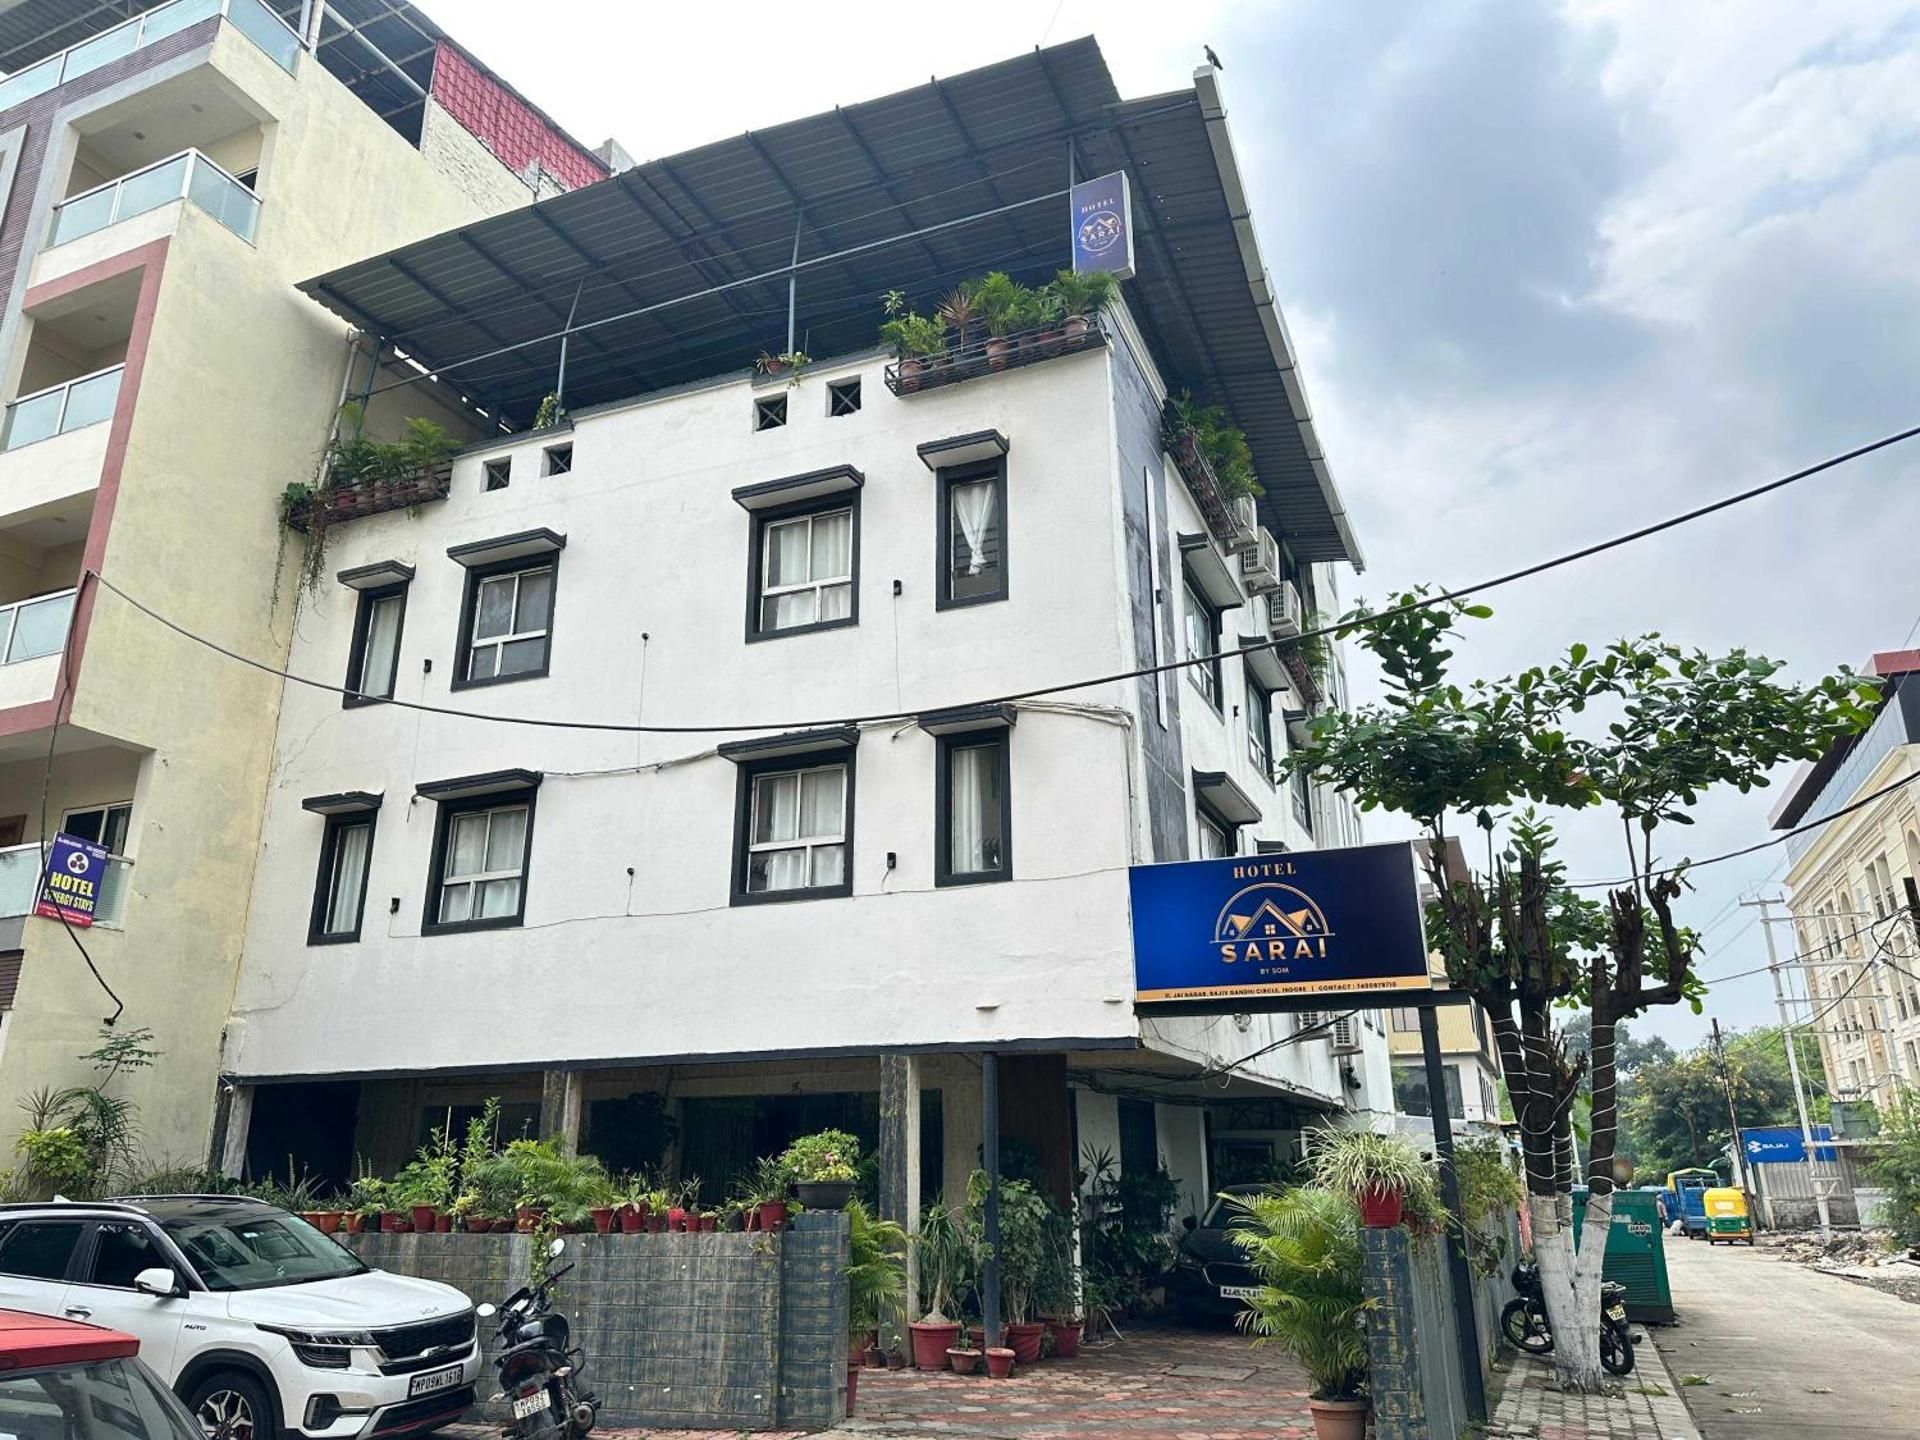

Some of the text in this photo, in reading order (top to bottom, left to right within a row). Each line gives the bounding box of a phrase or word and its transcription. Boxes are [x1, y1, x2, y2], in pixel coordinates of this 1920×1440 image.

[1233, 862, 1297, 879] HOTEL
[50, 872, 94, 897] HOTEL
[73, 897, 94, 912] STAYS
[1221, 938, 1326, 963] SARAI
[1230, 987, 1255, 995] GANDHI
[1318, 982, 1350, 991] CONTACT
[420, 1306, 439, 1315] KIA
